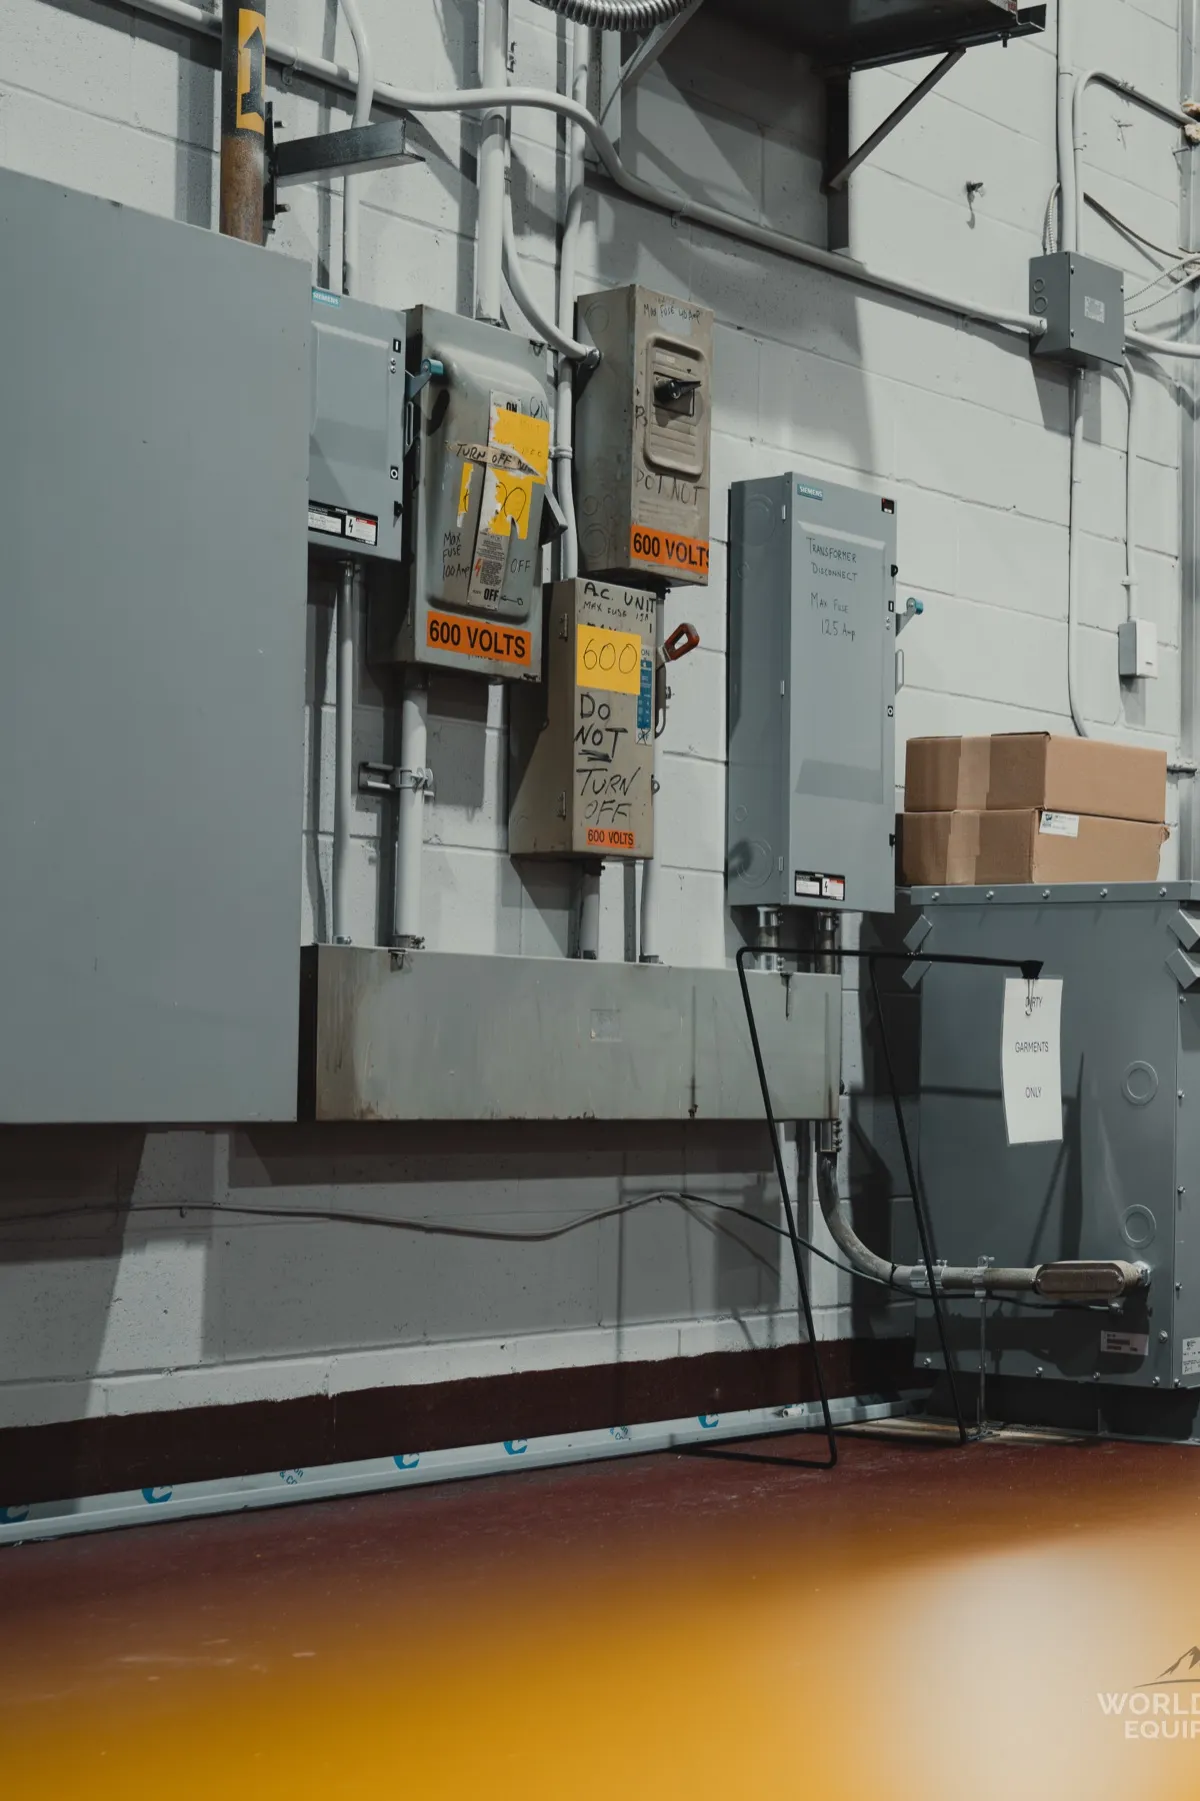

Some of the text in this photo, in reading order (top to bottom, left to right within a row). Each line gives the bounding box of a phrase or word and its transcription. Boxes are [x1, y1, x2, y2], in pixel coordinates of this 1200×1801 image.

[529, 396, 548, 419] ON
[456, 443, 487, 460] TURN
[491, 453, 513, 466] OFF
[671, 476, 709, 506] NOT
[799, 485, 823, 498] SIEMENS
[633, 532, 661, 558] 600
[510, 558, 532, 573] OFF
[483, 588, 500, 602] OFF
[624, 591, 657, 613] UNIT
[429, 619, 526, 659] 600 VOLTS
[583, 638, 638, 674] 600
[574, 723, 629, 759] NOT
[576, 766, 641, 797] TURN
[584, 799, 632, 826] OFF
[587, 828, 634, 847] 600 VOLTS
[1015, 1041, 1049, 1053] GARMENTS
[1025, 1086, 1042, 1099] ONLY
